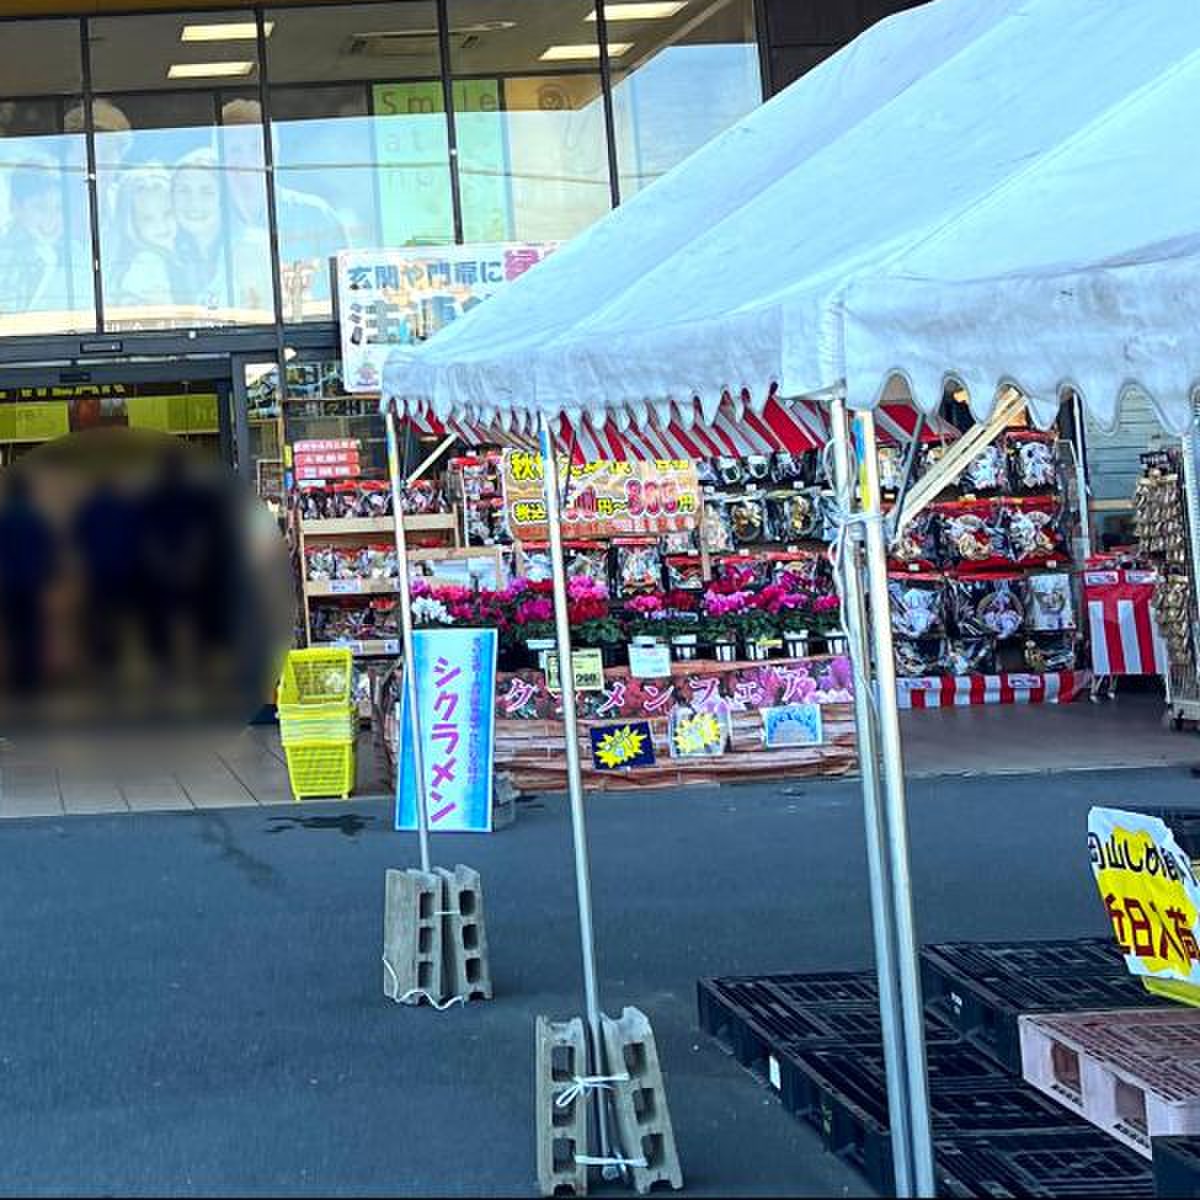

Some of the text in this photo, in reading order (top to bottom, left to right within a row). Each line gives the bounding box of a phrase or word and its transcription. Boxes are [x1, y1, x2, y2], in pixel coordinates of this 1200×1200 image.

[431, 656, 462, 823] シクラメン
